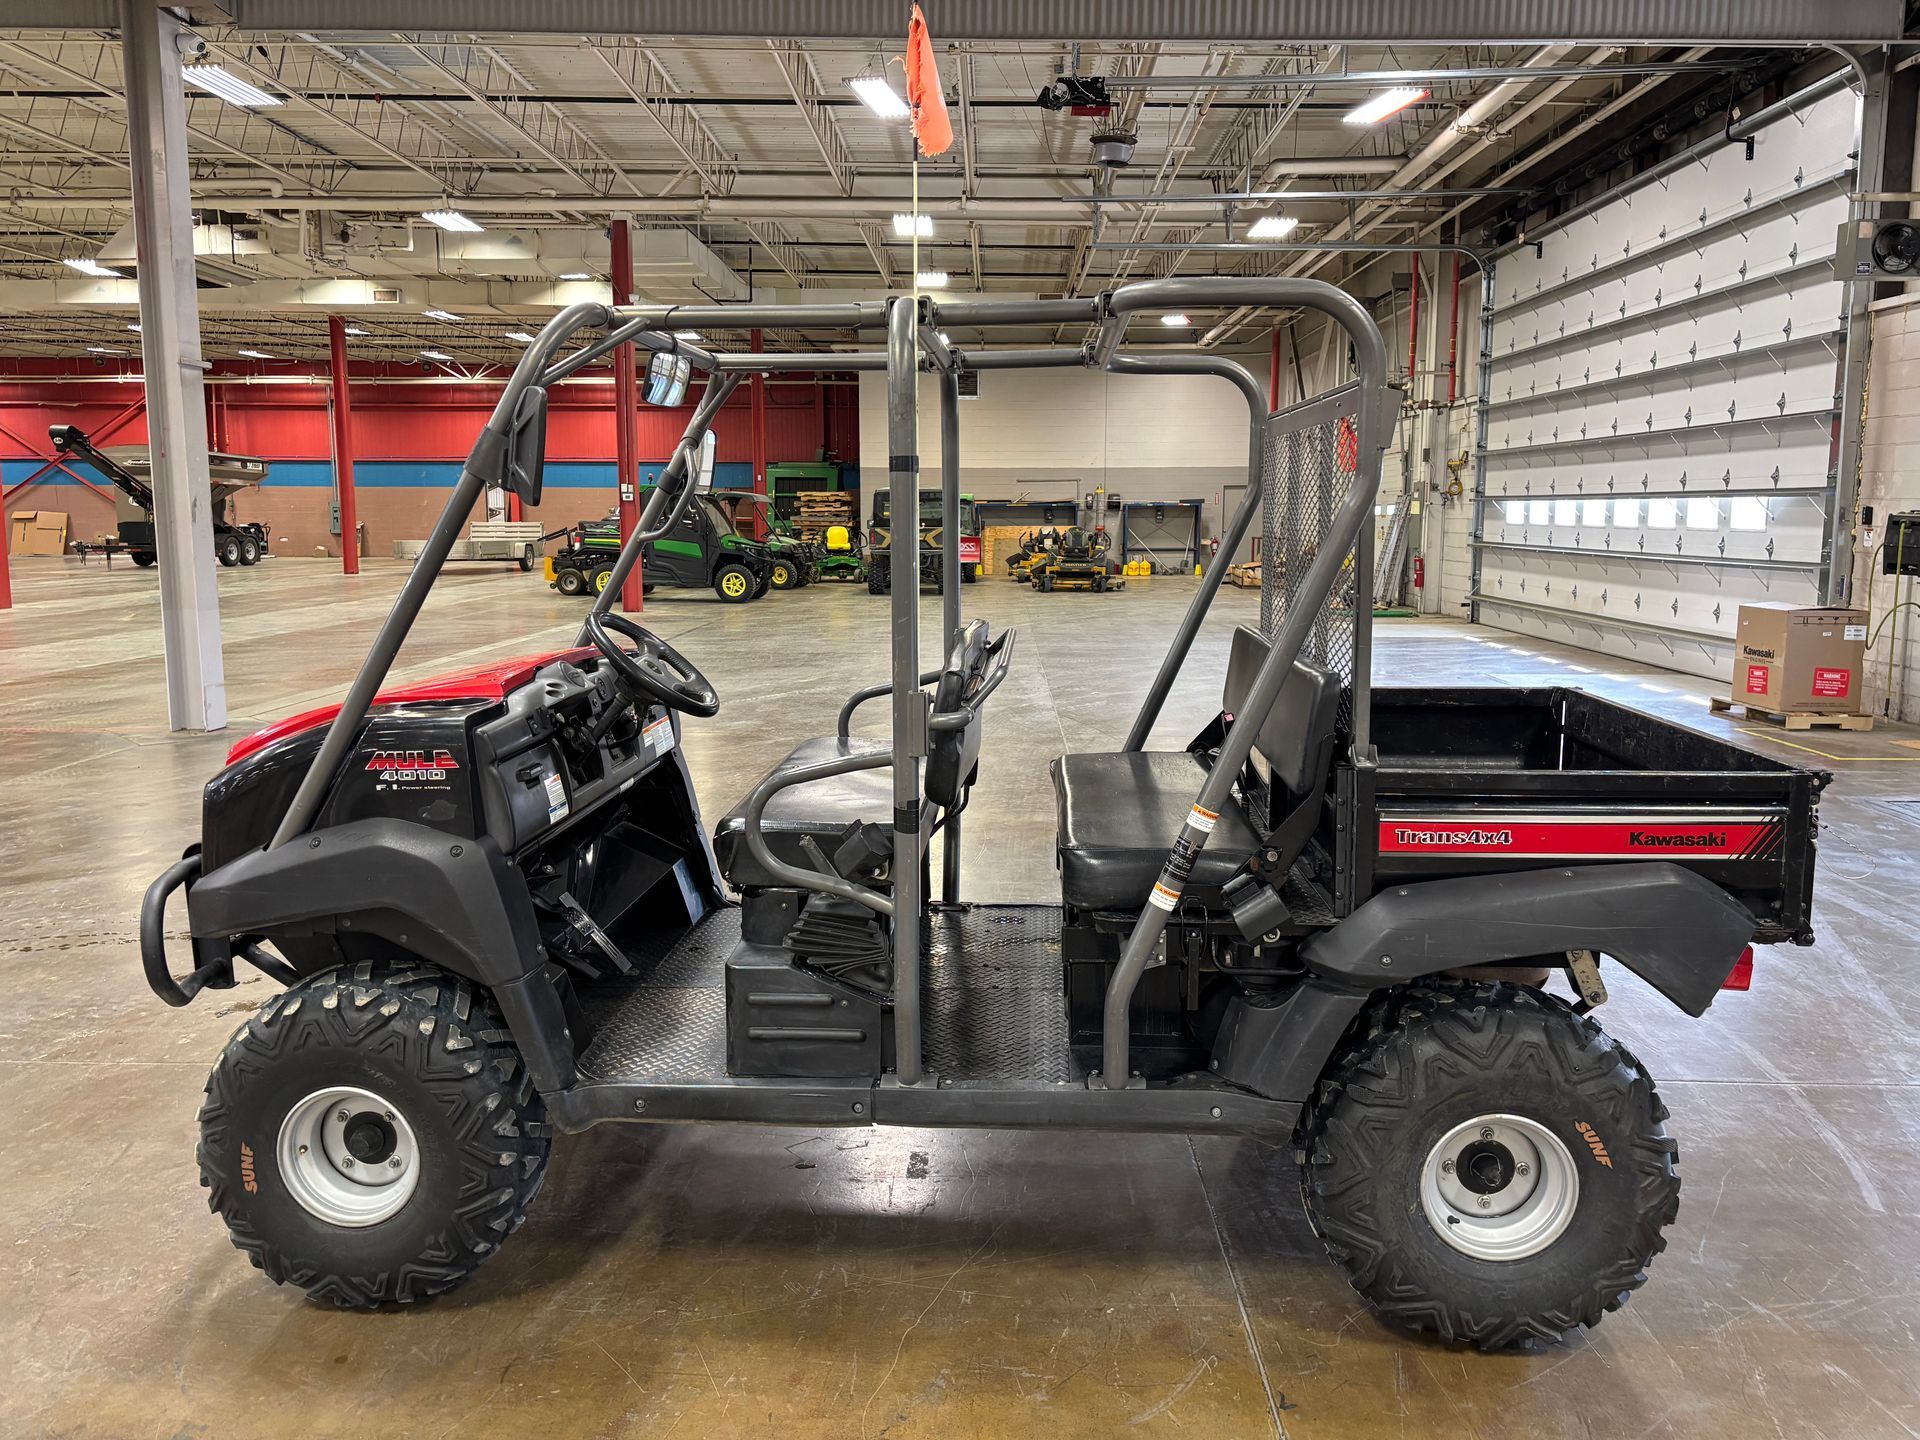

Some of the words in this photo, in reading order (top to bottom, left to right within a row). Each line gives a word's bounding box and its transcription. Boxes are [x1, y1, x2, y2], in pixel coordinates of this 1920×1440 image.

[1743, 645, 1775, 659] Kawasaki
[364, 749, 460, 770] MULE
[379, 769, 446, 781] 4010
[1395, 828, 1512, 846] Trans4x4
[1629, 831, 1726, 847] Kawasaki
[1575, 1120, 1614, 1170] SUNF
[240, 1141, 258, 1195] SUNF
